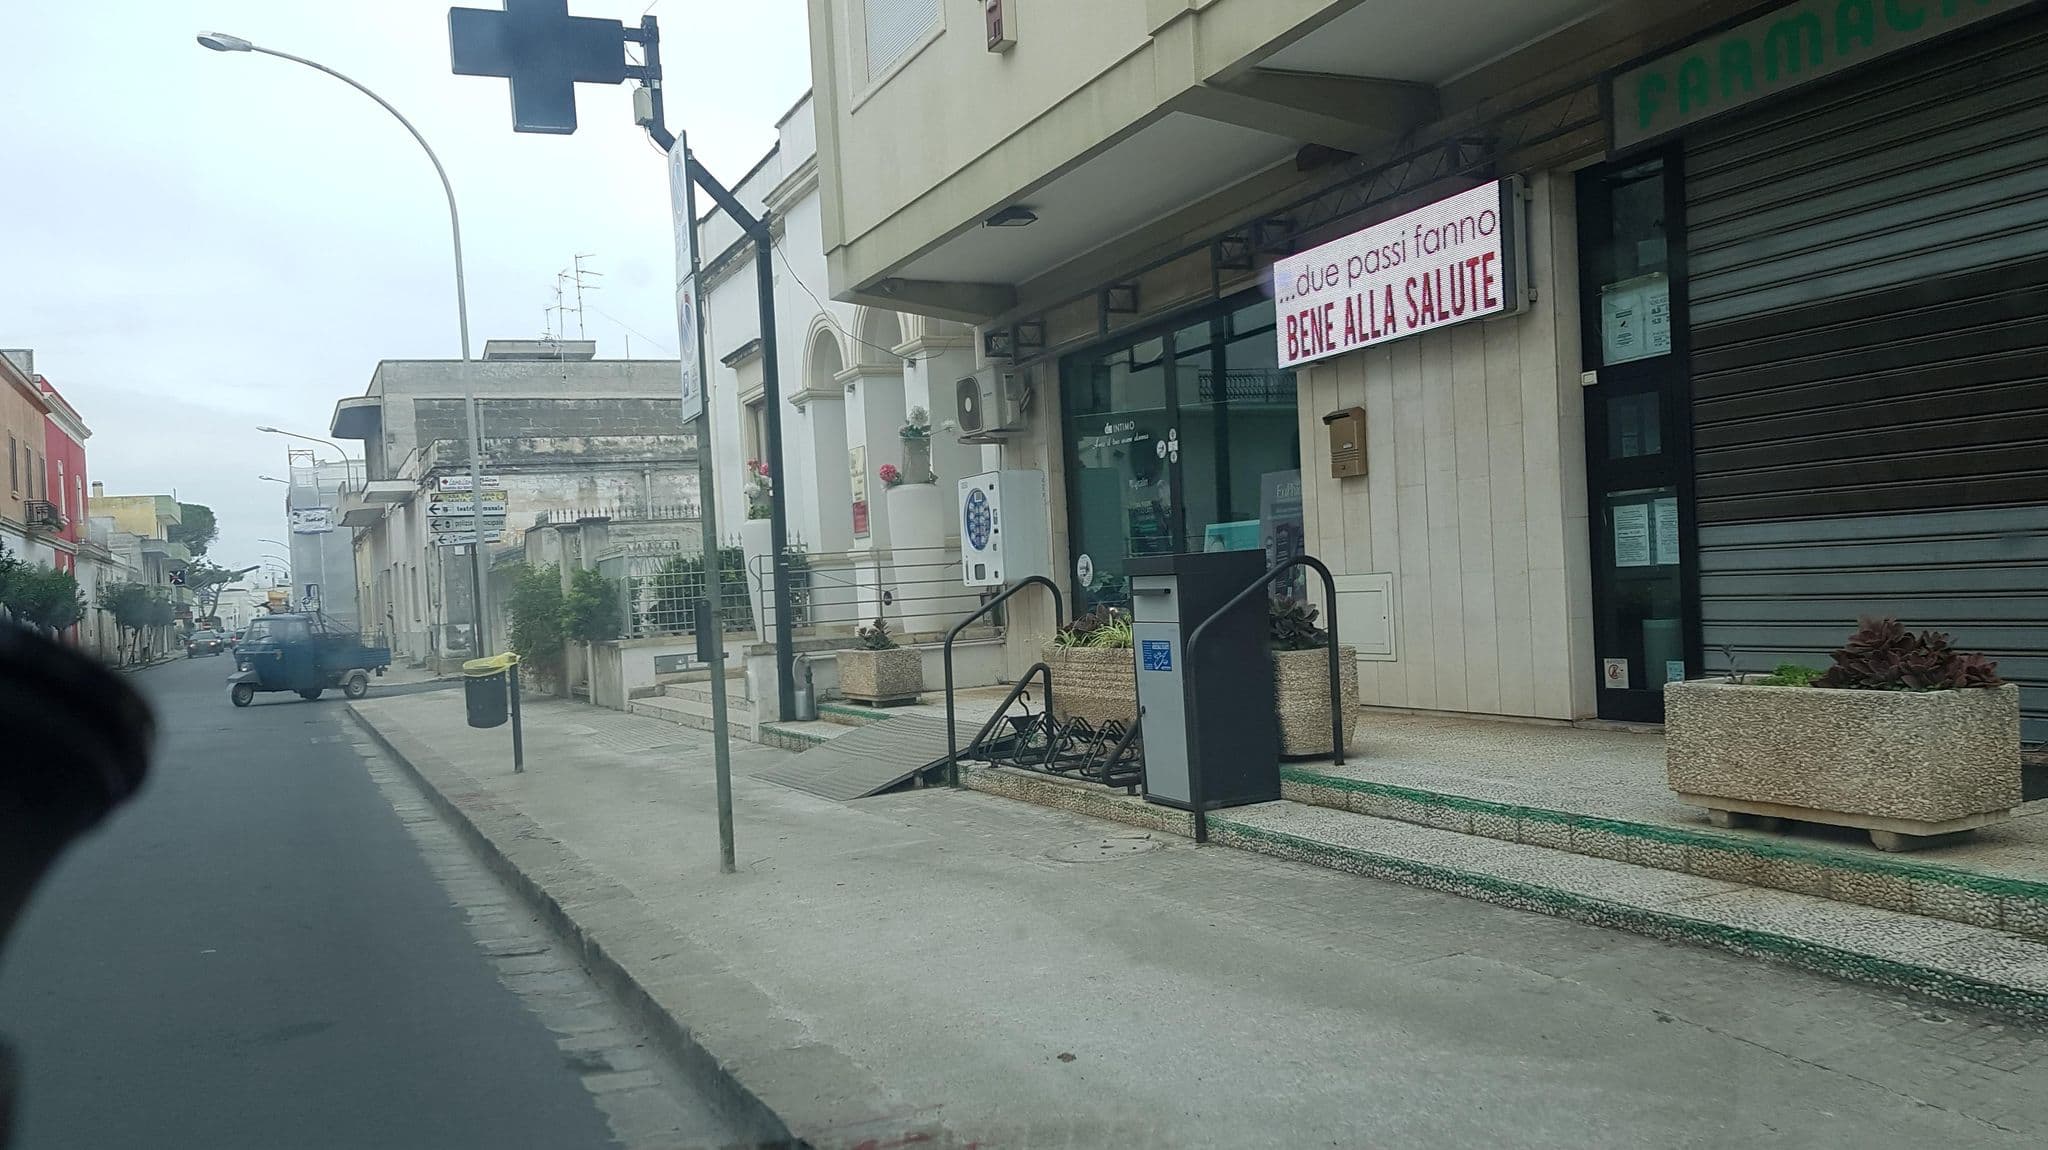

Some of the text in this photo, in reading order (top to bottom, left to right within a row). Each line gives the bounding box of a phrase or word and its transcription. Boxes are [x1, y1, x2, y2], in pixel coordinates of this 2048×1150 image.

[1637, 0, 1993, 129] FARMAC
[1280, 209, 1497, 303] ...due passi fanno
[1286, 251, 1498, 361] BENE ALLA SALUTE
[1113, 420, 1135, 433] INTIMO
